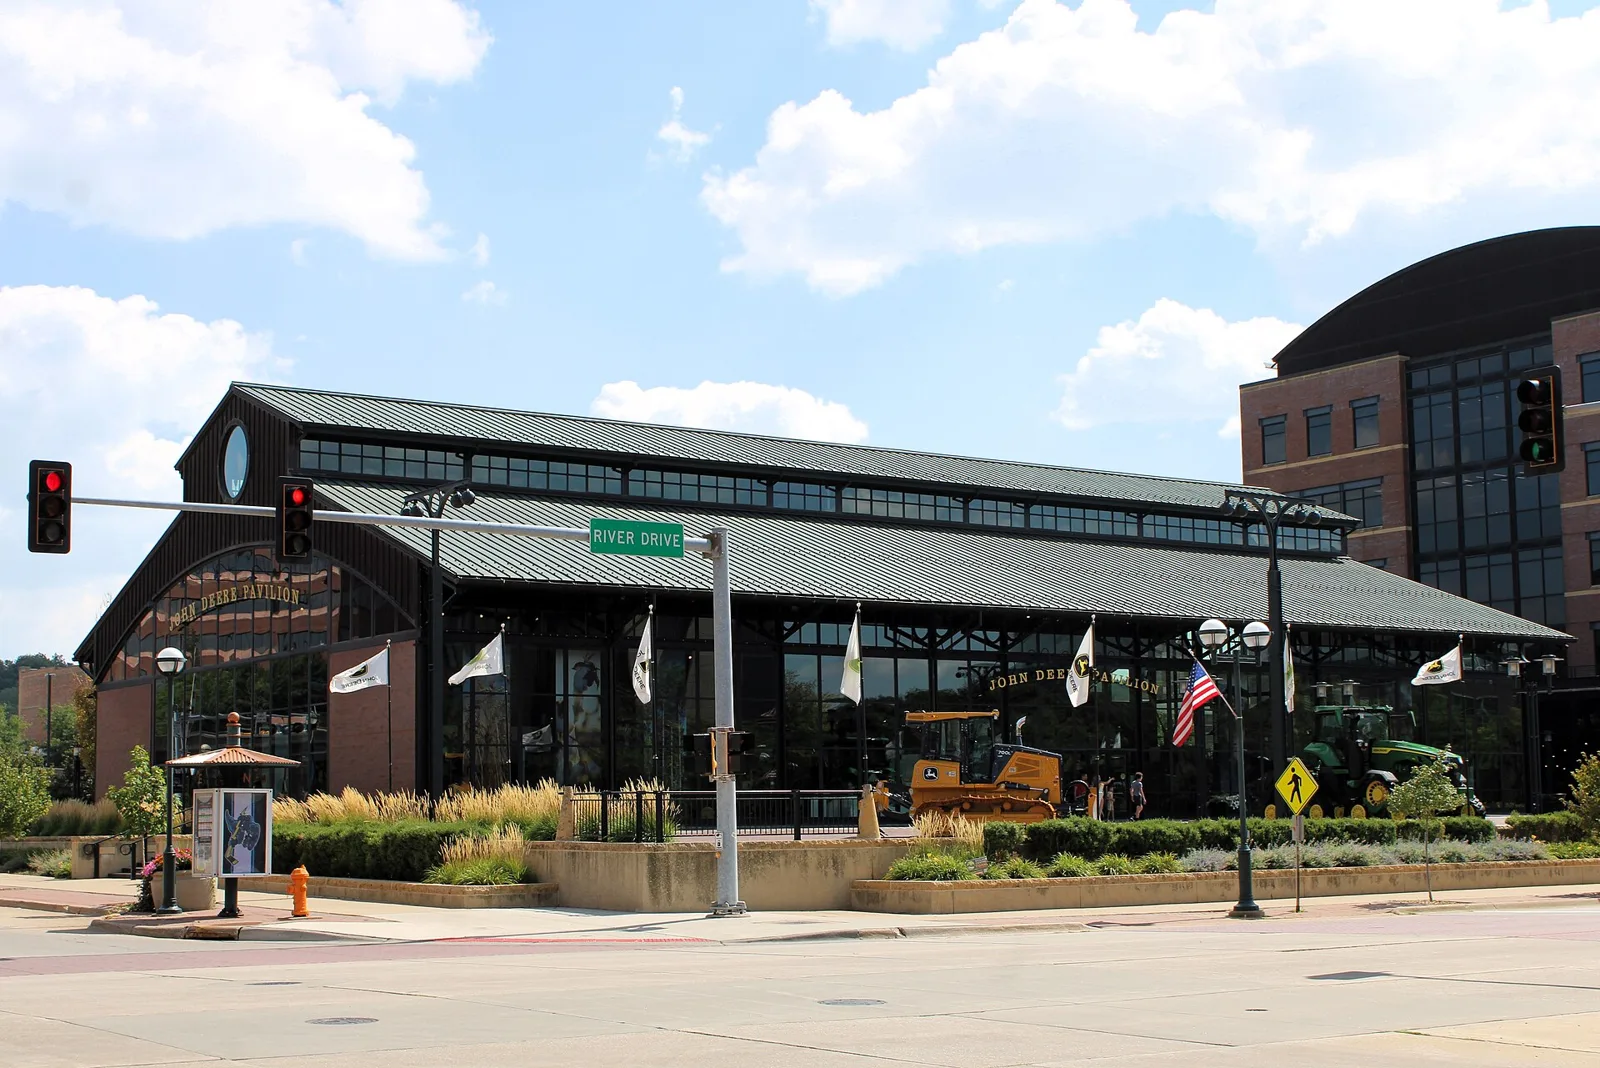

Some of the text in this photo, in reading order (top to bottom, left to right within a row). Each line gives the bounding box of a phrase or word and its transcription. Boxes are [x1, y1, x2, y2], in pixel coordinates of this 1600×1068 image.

[594, 529, 680, 547] RIVER DRIVE
[169, 583, 300, 631] JOHN DEERE PAVILION
[989, 672, 1028, 690] JOHN
[1036, 668, 1070, 681] DEE
